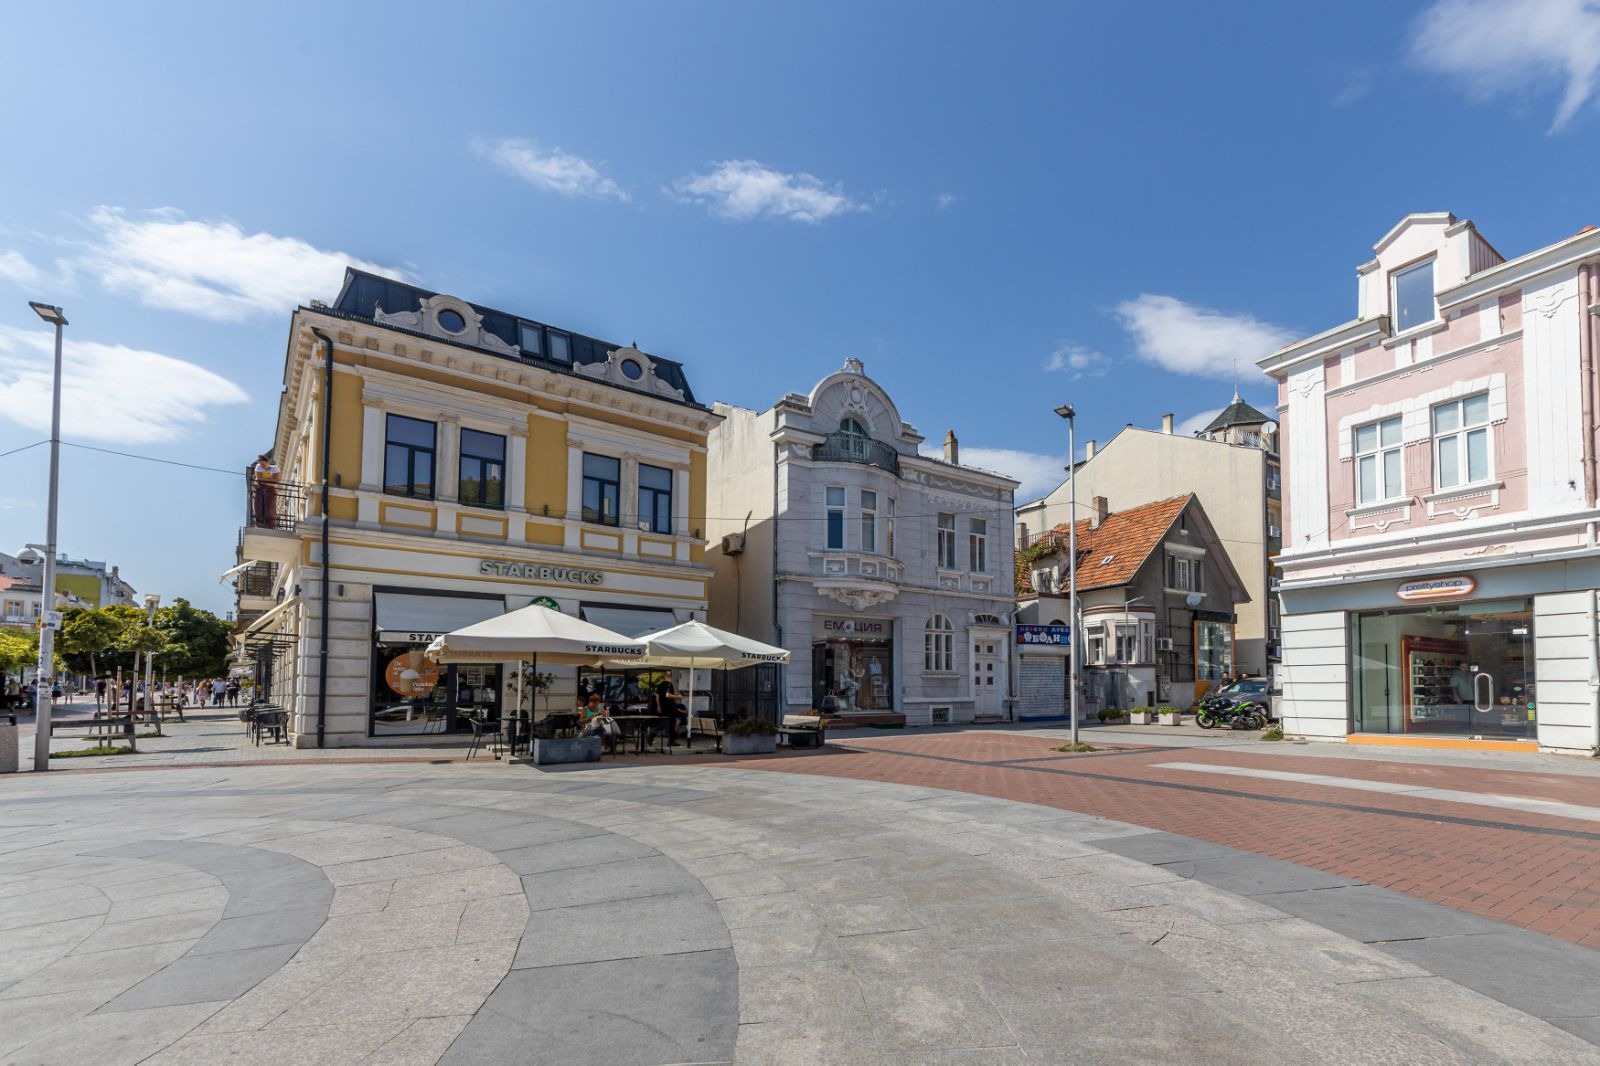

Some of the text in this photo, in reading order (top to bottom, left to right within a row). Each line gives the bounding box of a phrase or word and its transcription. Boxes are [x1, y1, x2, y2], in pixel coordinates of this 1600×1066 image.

[480, 560, 604, 585] STARBUCKS
[1406, 580, 1463, 591] prettyshop
[585, 645, 642, 655] STARBUCKS
